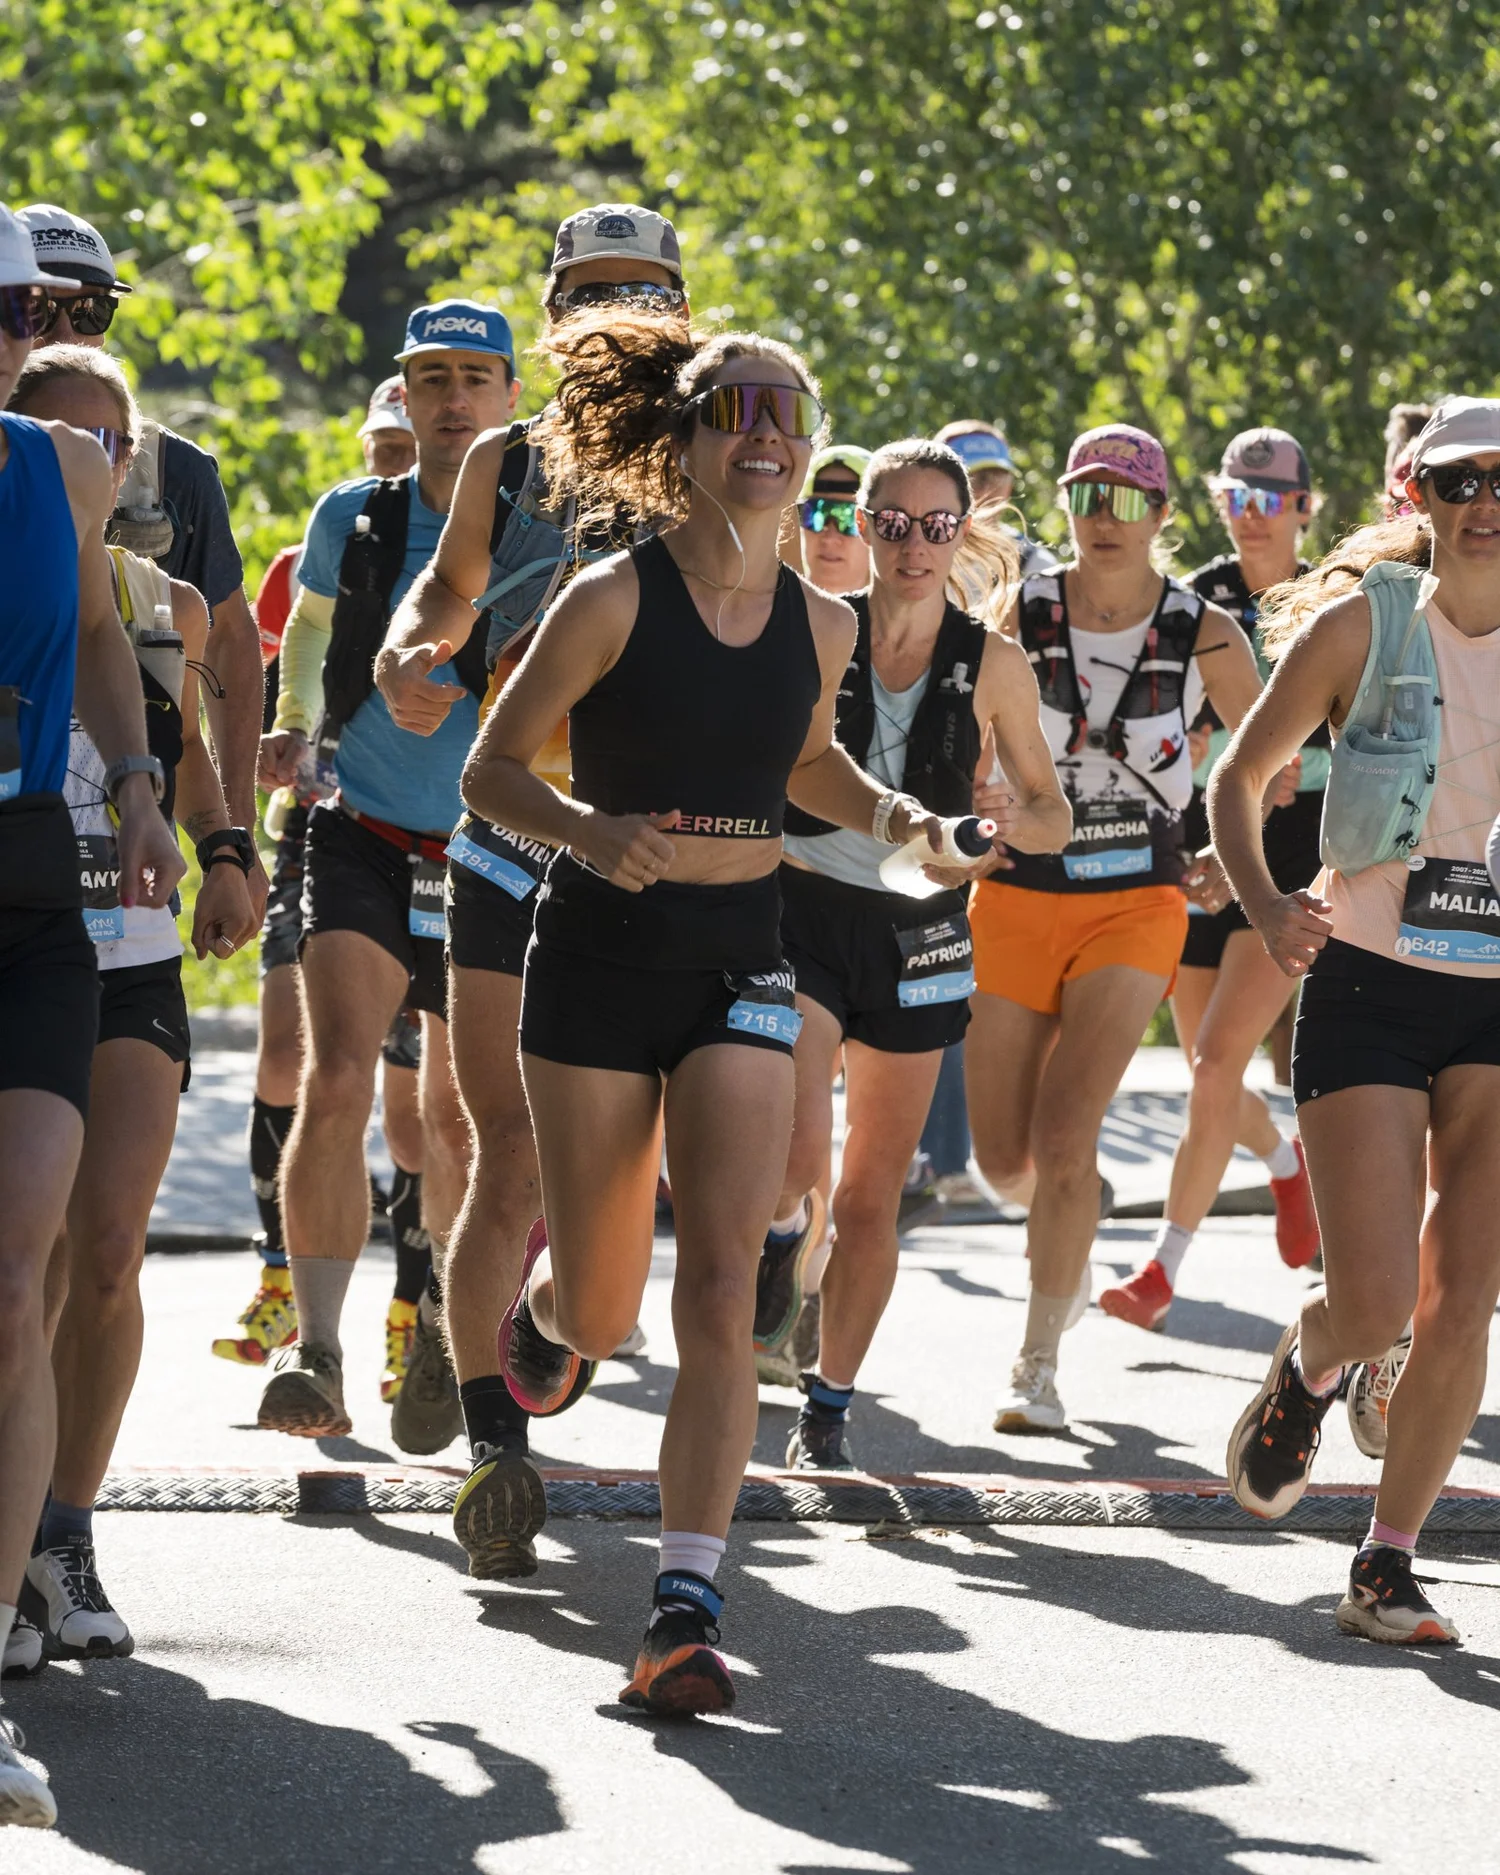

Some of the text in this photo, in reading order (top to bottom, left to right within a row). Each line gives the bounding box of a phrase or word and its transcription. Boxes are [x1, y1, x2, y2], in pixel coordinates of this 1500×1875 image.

[423, 316, 488, 339] HOKA
[1348, 762, 1399, 776] SALOMON
[650, 812, 770, 836] ERRELL
[1071, 820, 1150, 842] ATASCHA
[459, 847, 492, 872] 794
[1451, 865, 1468, 873] 2007
[1429, 891, 1500, 917] MALIA
[907, 938, 973, 970] PATRICIA
[1411, 936, 1450, 956] 642
[908, 985, 938, 1002] 717
[741, 1011, 778, 1033] 715
[672, 1579, 705, 1598] ZONE4
